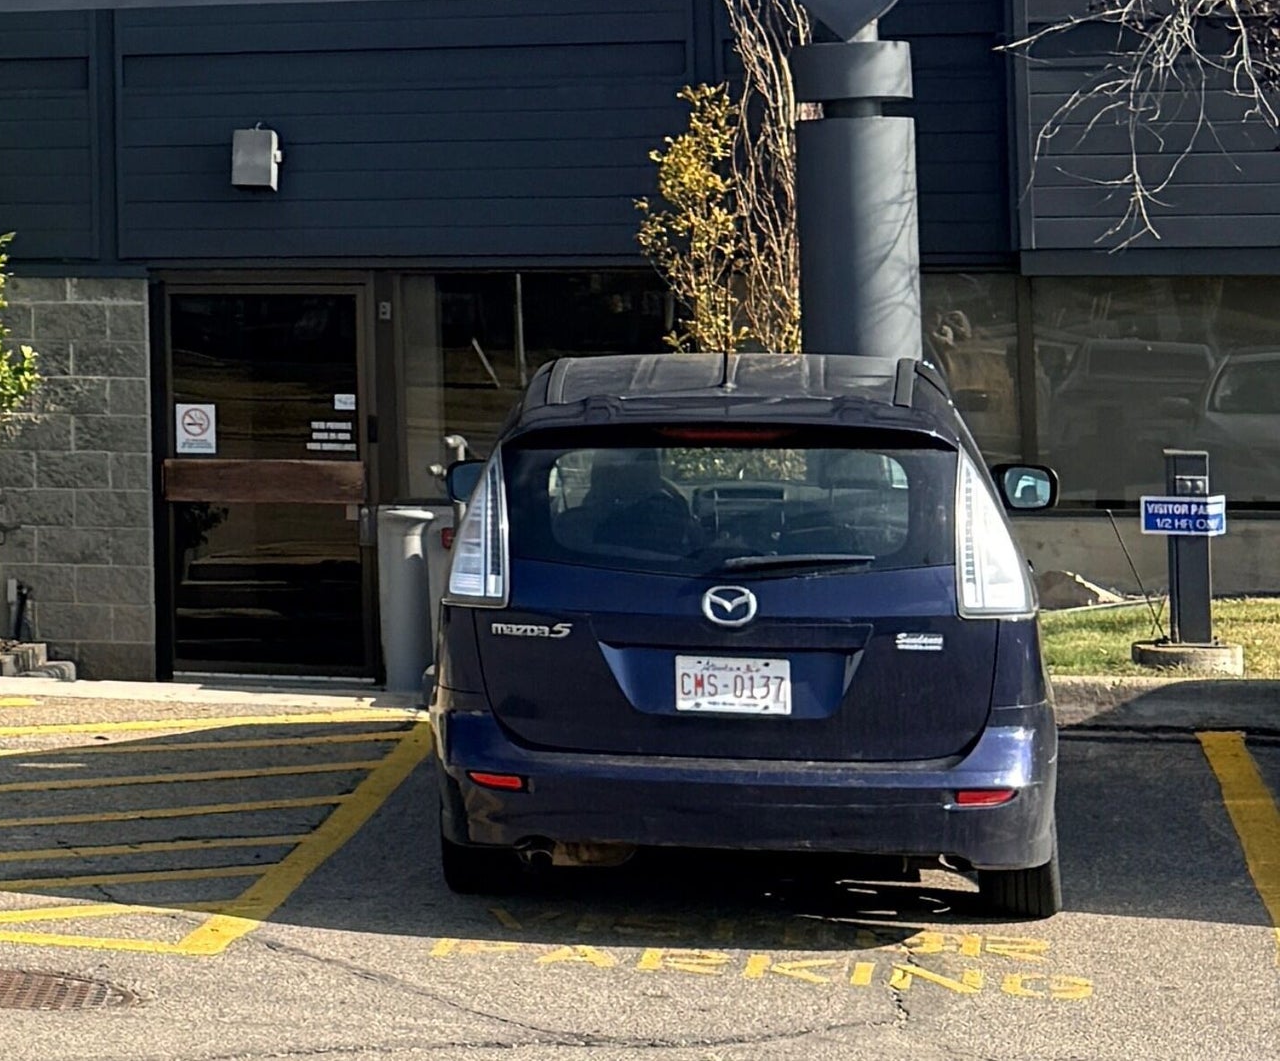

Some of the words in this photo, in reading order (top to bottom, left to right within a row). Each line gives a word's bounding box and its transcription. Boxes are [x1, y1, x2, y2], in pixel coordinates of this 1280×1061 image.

[1146, 502, 1189, 515] VISITOR
[1155, 517, 1172, 529] 1/2
[428, 936, 1094, 1000] PARKING
